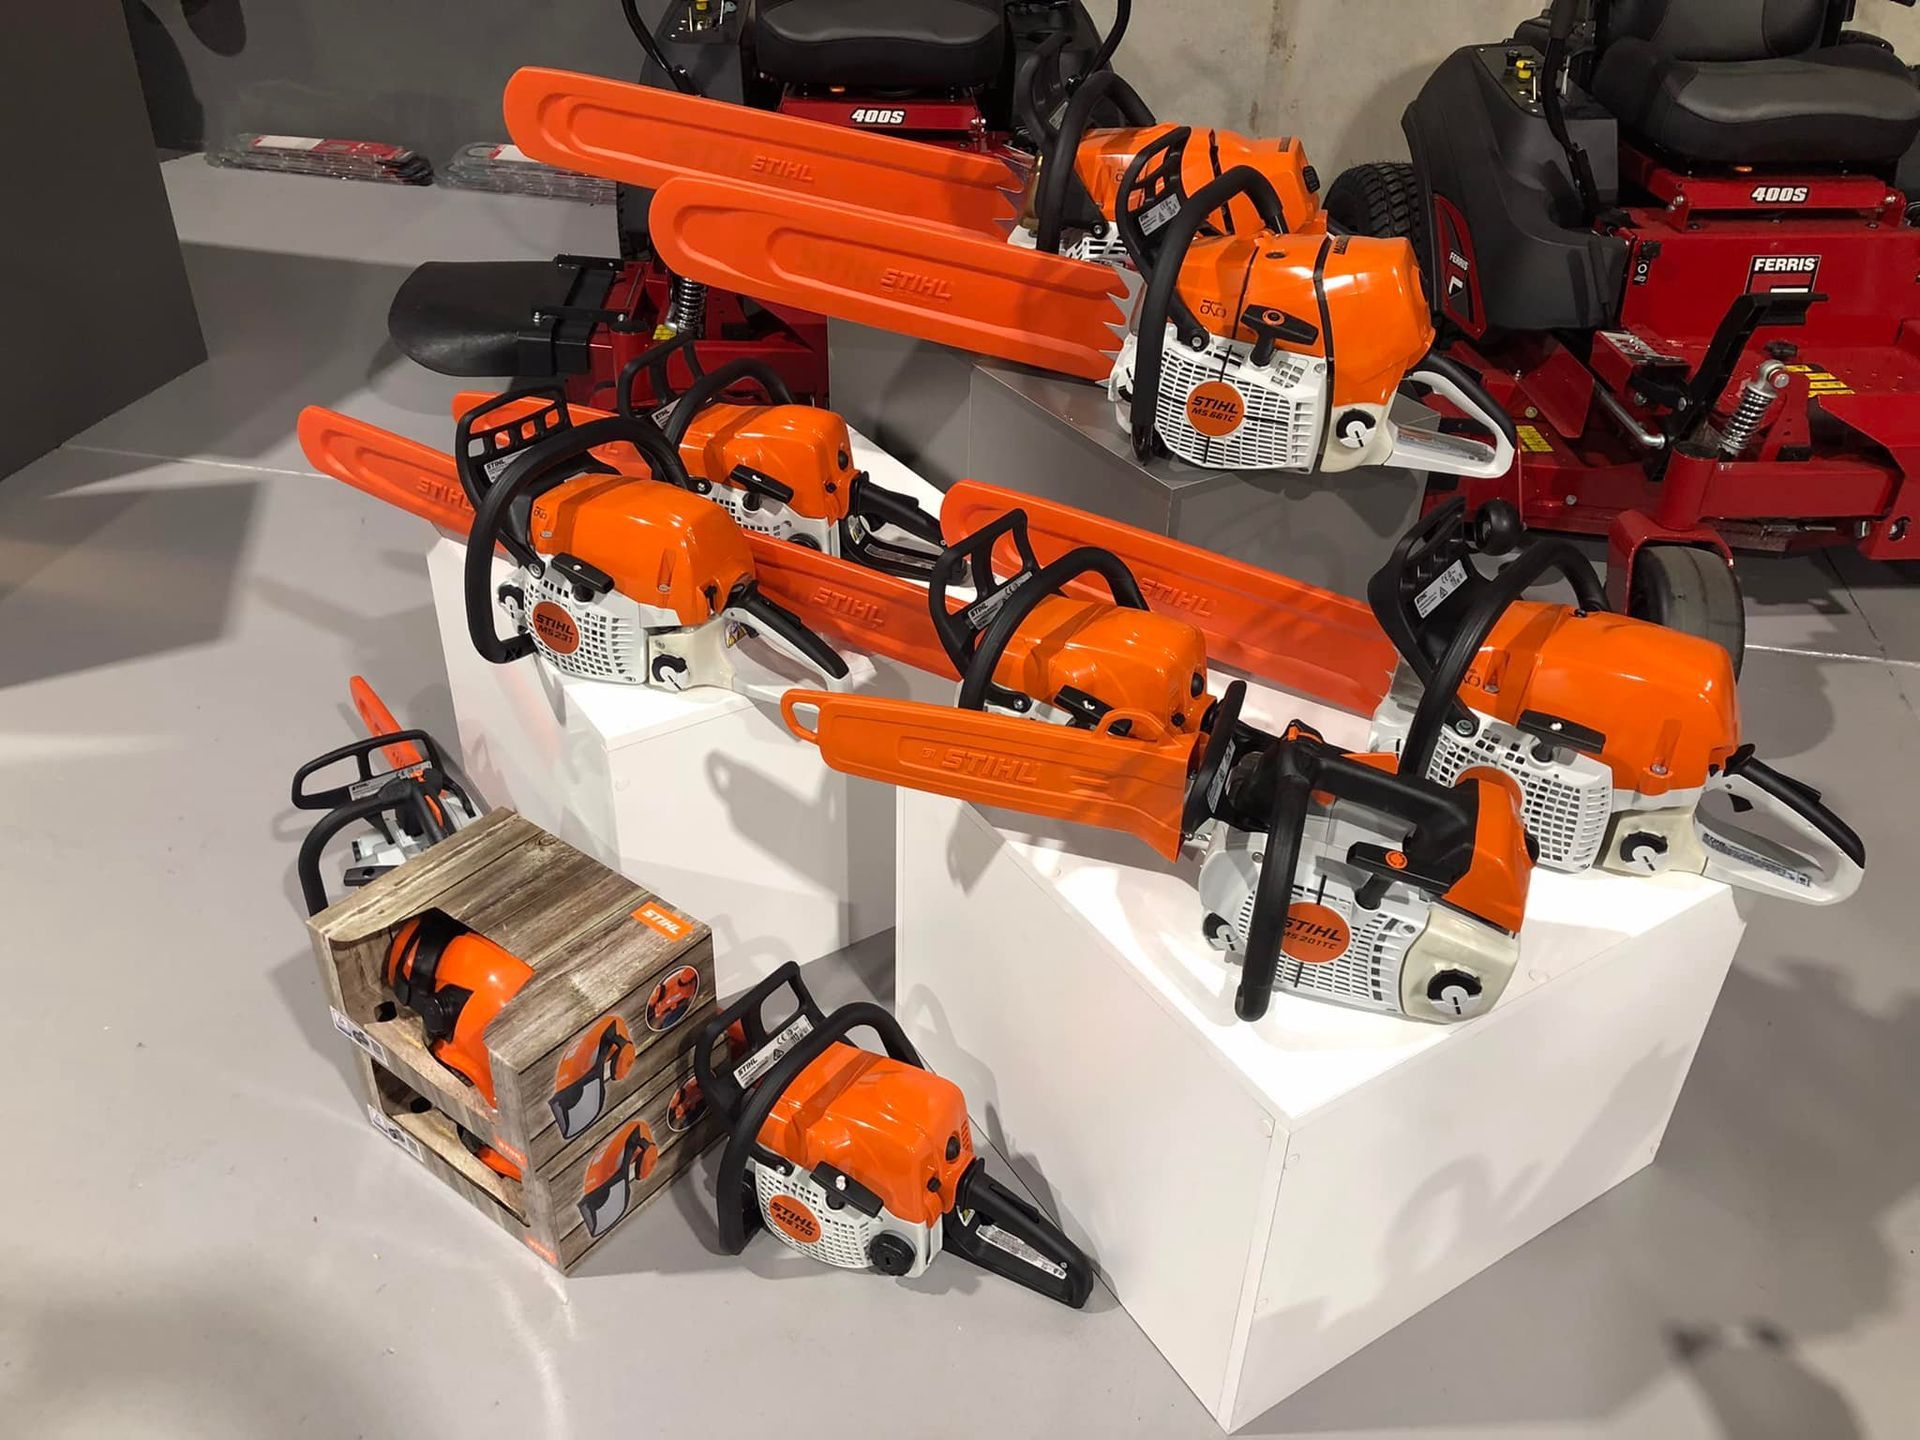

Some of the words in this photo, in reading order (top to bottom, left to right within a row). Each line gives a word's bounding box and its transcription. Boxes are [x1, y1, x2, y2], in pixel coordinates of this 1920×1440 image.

[851, 109, 905, 124] 400S
[751, 155, 814, 183] STIHL
[1751, 187, 1808, 202] 400S
[1450, 251, 1469, 271] FERRIS
[1753, 257, 1816, 272] FERRIS
[880, 267, 952, 300] STIHL
[1190, 395, 1239, 415] STIHL
[813, 586, 885, 625] STIHL
[1140, 577, 1212, 617] STIHL
[535, 613, 574, 636] STIHL
[942, 747, 1038, 785] STIHL
[641, 909, 681, 935] STIHL
[1285, 916, 1342, 942] STIHL
[737, 1058, 758, 1076] STIHL
[770, 1201, 816, 1232] STIHL
